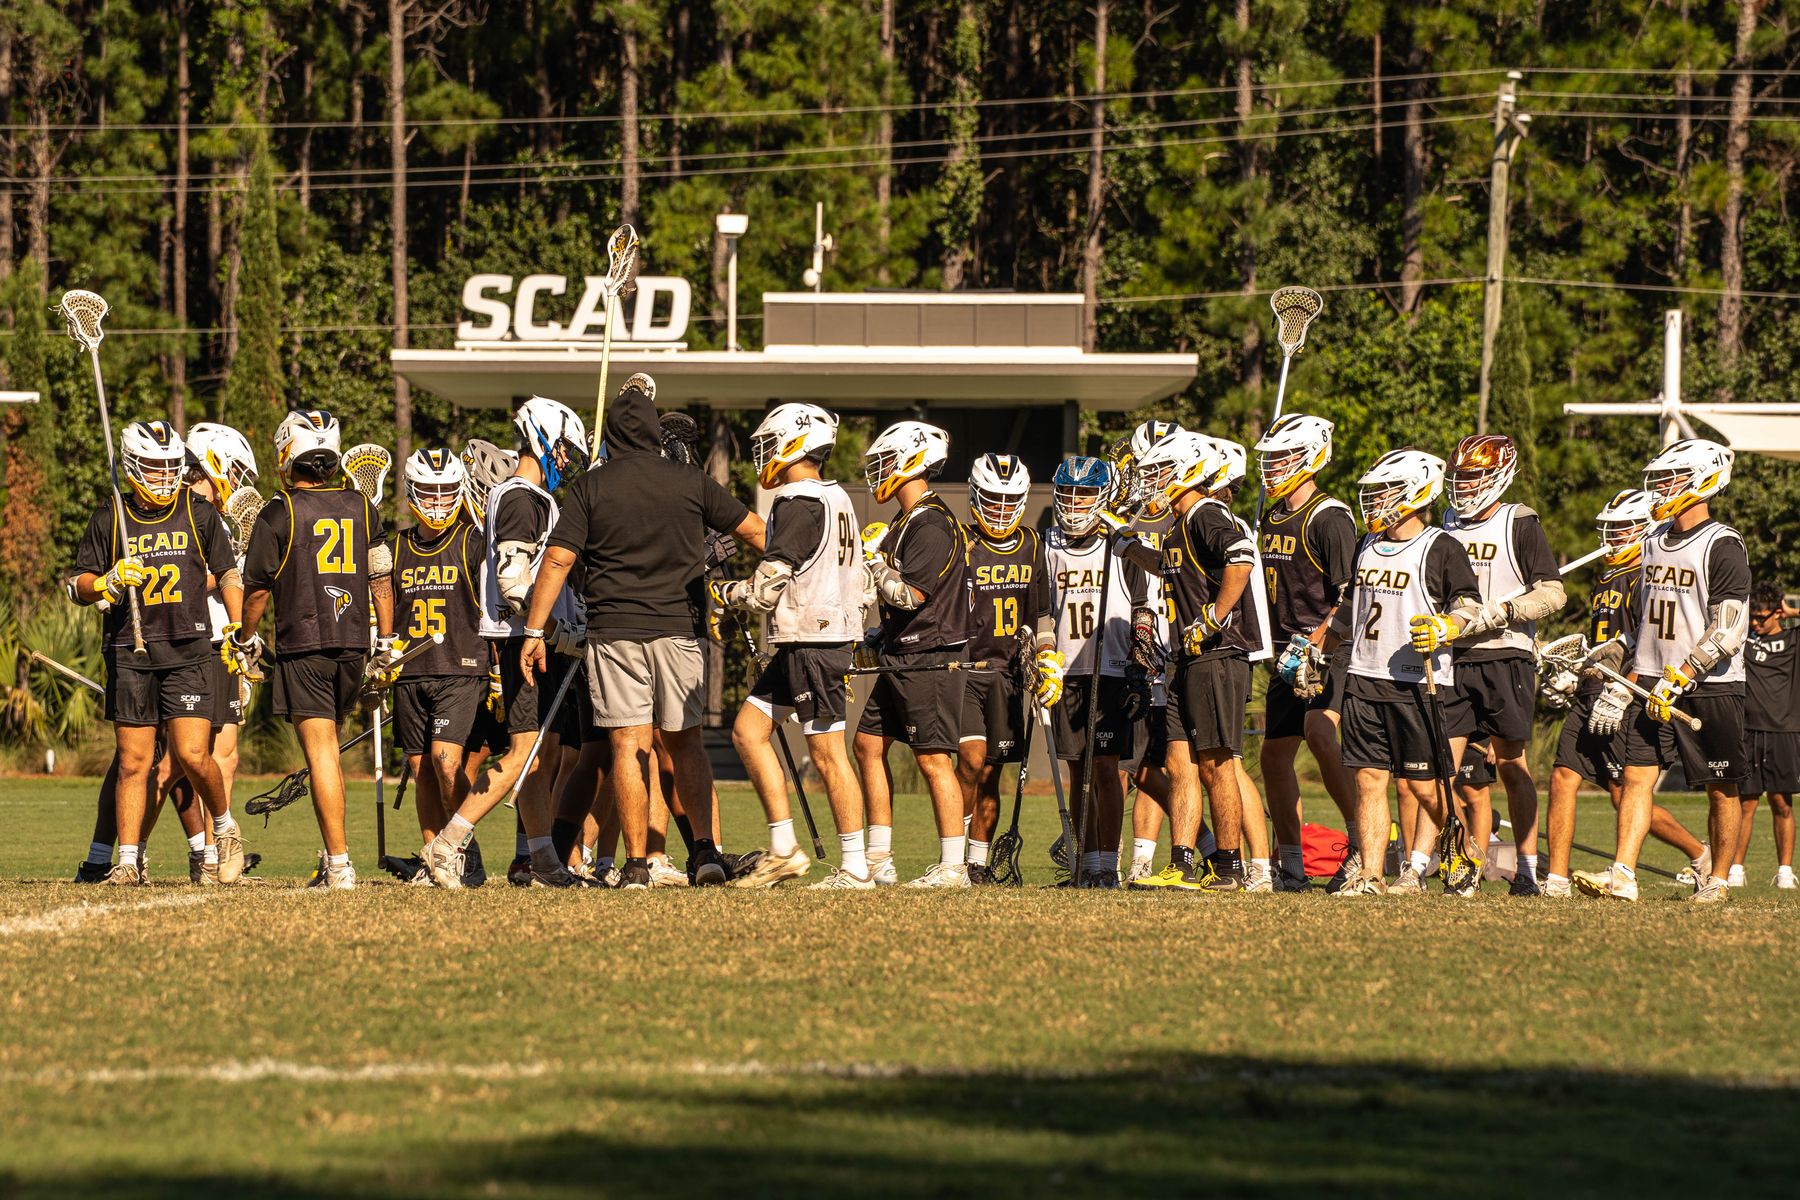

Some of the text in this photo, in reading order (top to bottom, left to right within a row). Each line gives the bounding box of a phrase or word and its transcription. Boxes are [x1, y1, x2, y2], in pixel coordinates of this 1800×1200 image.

[457, 273, 692, 341] SCAD
[795, 414, 811, 430] 94
[1321, 429, 1328, 442] 8
[1712, 453, 1723, 467] 41
[127, 531, 188, 556] SCAD
[313, 518, 356, 574] 21
[838, 512, 855, 567] 94
[1262, 533, 1296, 555] CAD
[151, 550, 186, 558] LACROSSE
[1162, 547, 1183, 568] AD
[1467, 543, 1497, 560] AD
[142, 563, 183, 606] 22
[401, 565, 458, 588] SCAD
[976, 565, 1032, 585] SCAD
[1355, 568, 1411, 590] SCAD
[1645, 564, 1695, 588] SCAD
[1373, 588, 1404, 596] ACROSSE
[1592, 589, 1623, 611] CAD
[408, 598, 447, 638] 35
[993, 597, 1018, 637] 13
[1068, 601, 1094, 640] 16
[1364, 601, 1383, 641] 2
[1649, 598, 1677, 641] 41
[1096, 731, 1114, 739] SCAD
[1708, 760, 1730, 768] SCAD
